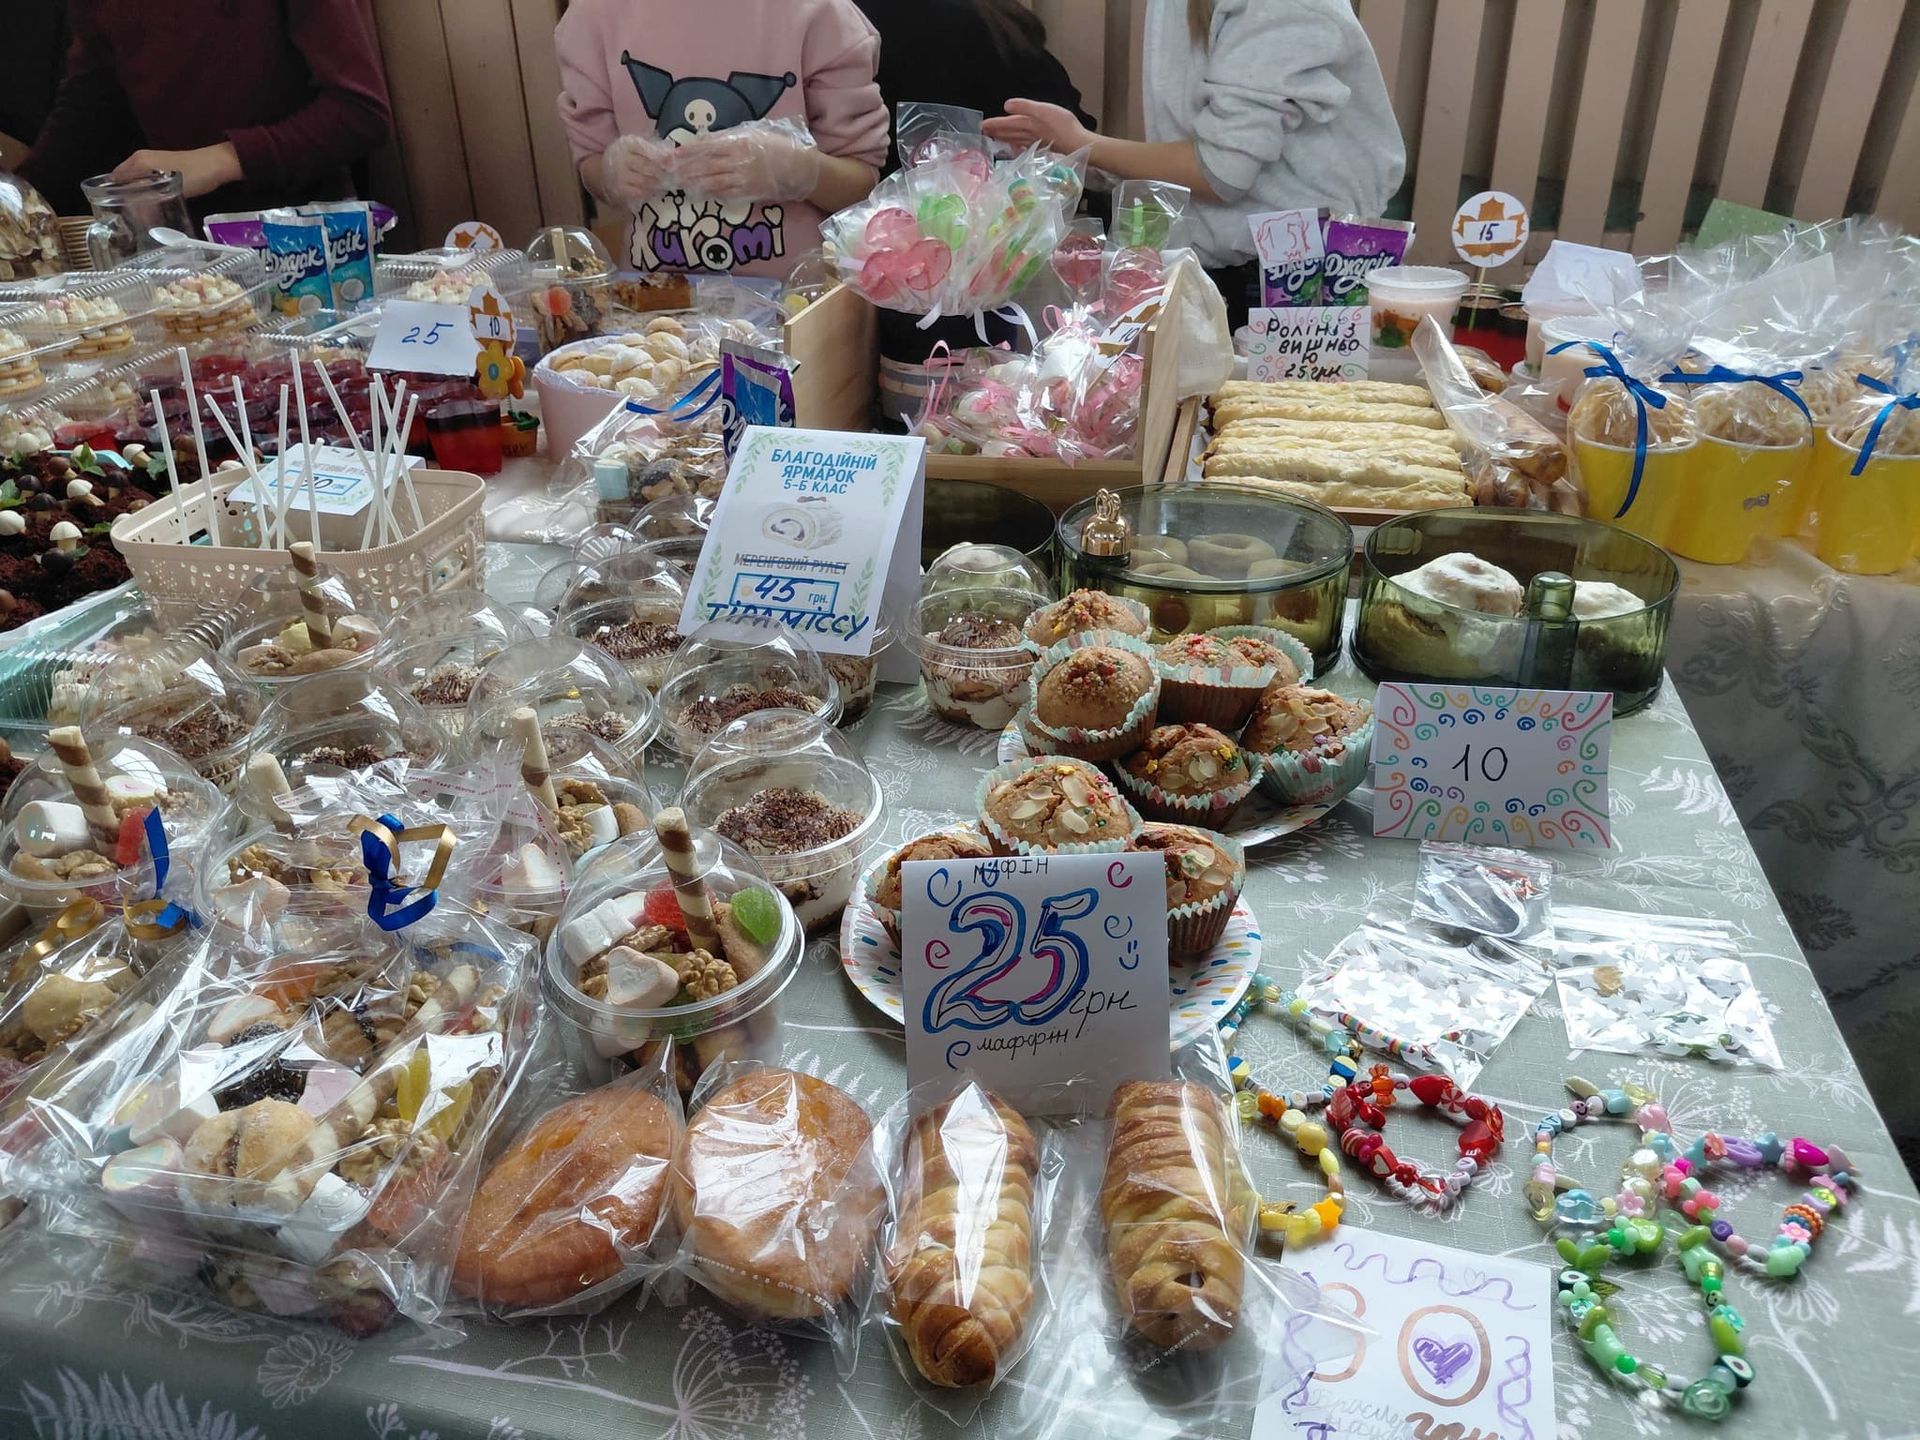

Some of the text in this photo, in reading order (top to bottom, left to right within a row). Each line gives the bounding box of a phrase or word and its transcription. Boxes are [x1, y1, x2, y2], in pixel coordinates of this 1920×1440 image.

[630, 202, 786, 272] Kuromi
[1479, 223, 1500, 241] 15
[401, 322, 454, 345] 25
[489, 316, 500, 337] 10
[781, 465, 858, 484] ЯРМАРОК
[784, 479, 847, 494] 5-Б КЛАС
[755, 574, 815, 602] 45
[1451, 744, 1508, 782] 10
[923, 888, 1099, 1034] 25
[1069, 989, 1137, 1039] грн
